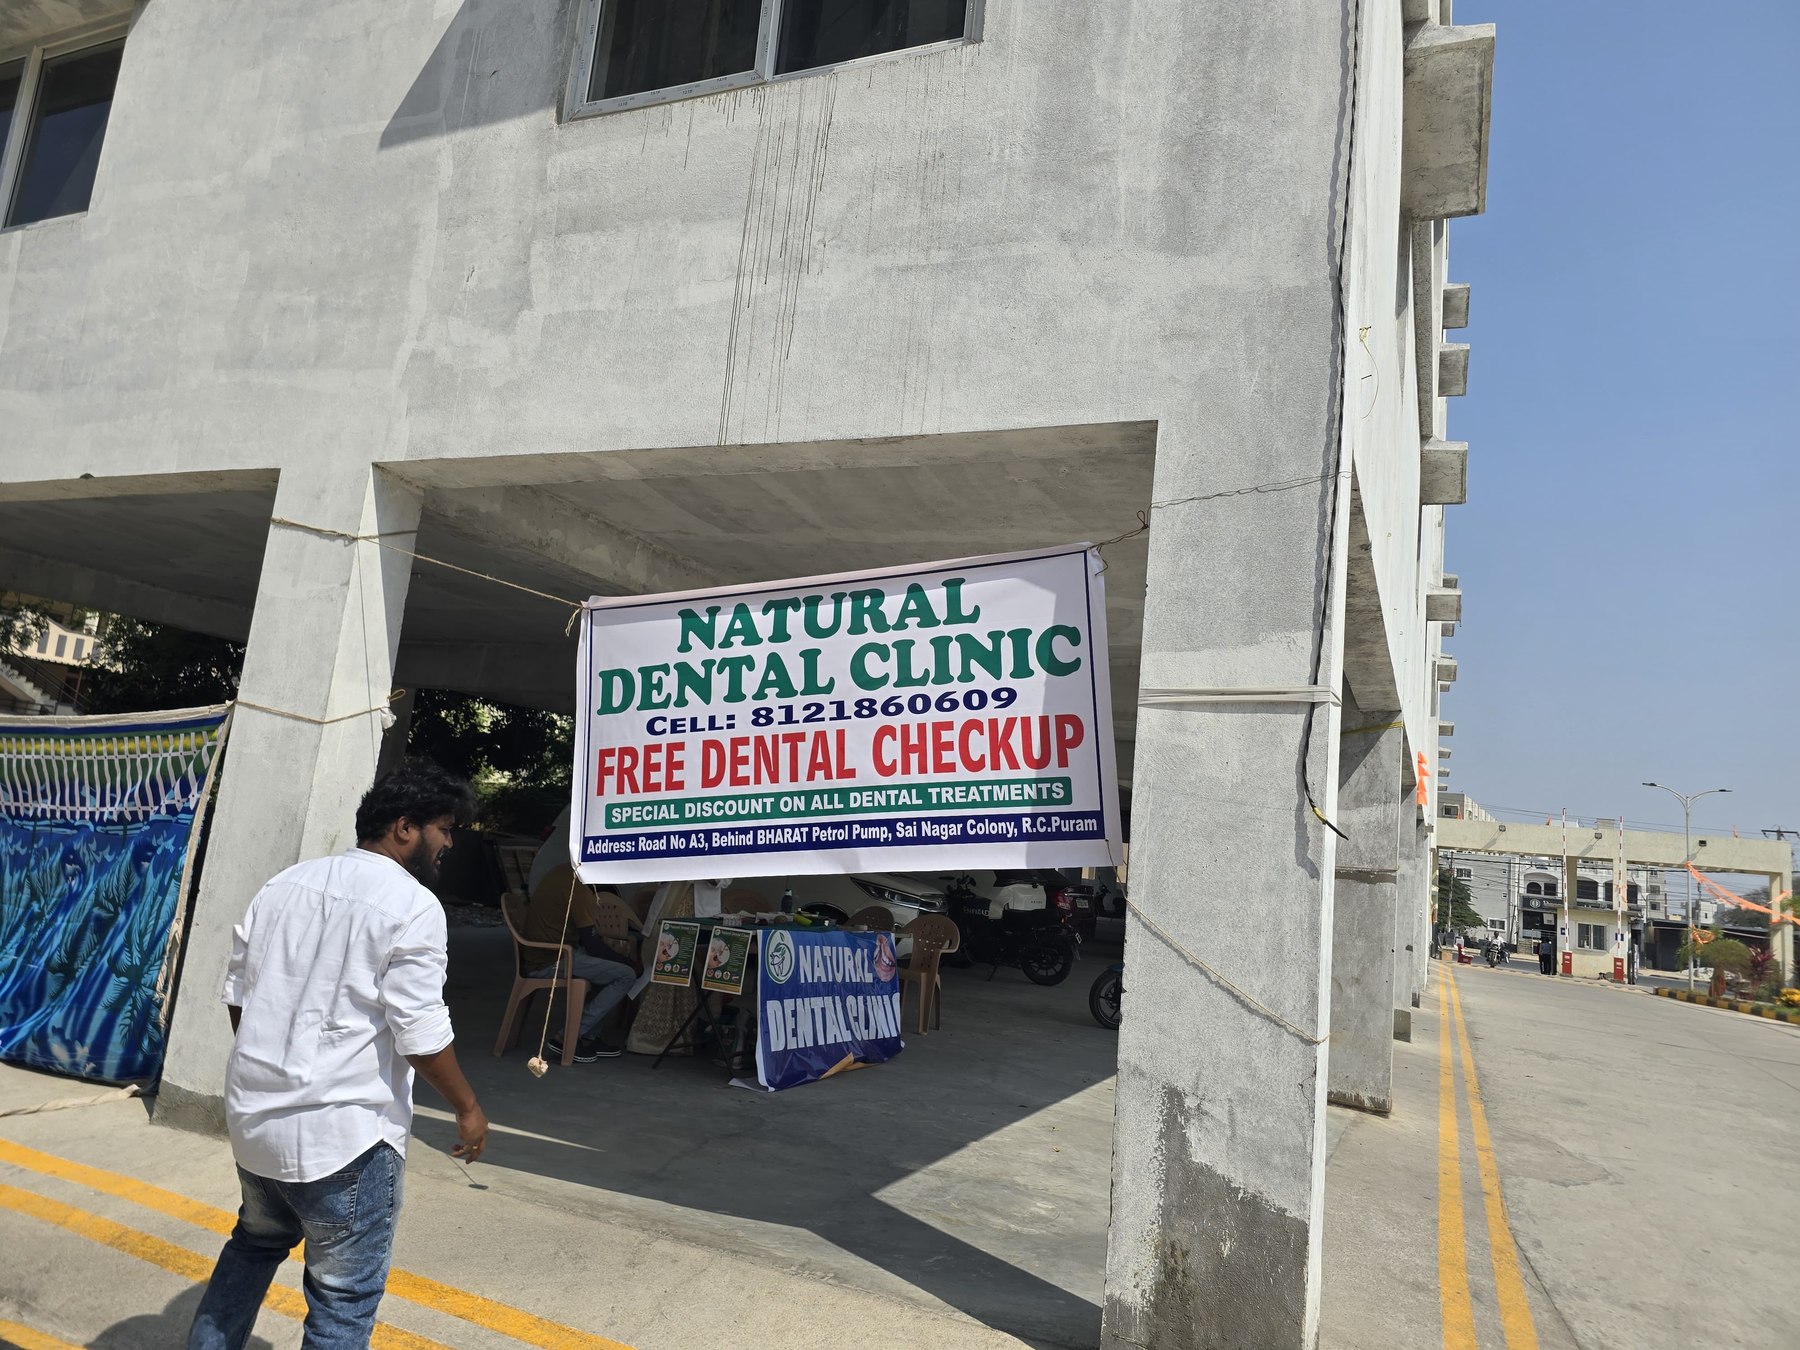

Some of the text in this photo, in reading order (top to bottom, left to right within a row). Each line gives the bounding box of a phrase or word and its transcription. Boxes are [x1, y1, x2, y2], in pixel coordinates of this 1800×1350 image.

[677, 578, 980, 653] NATURAL
[597, 625, 1081, 715] DENTAL CLINIC
[646, 687, 1017, 736] CELL: 8121860609
[597, 715, 1083, 796] FREE DENTAL CHECKUP
[612, 782, 1065, 823] SPECIAL DISCOUNT ON ALL DENTAL TREATMENTS
[587, 816, 1097, 854] Address: Road No A3, Behind BHARAT Petrol Pump, Sai Nagar Colony, R.C.Puram
[799, 945, 874, 984] NATURAL
[766, 995, 852, 1052] DENTAL
